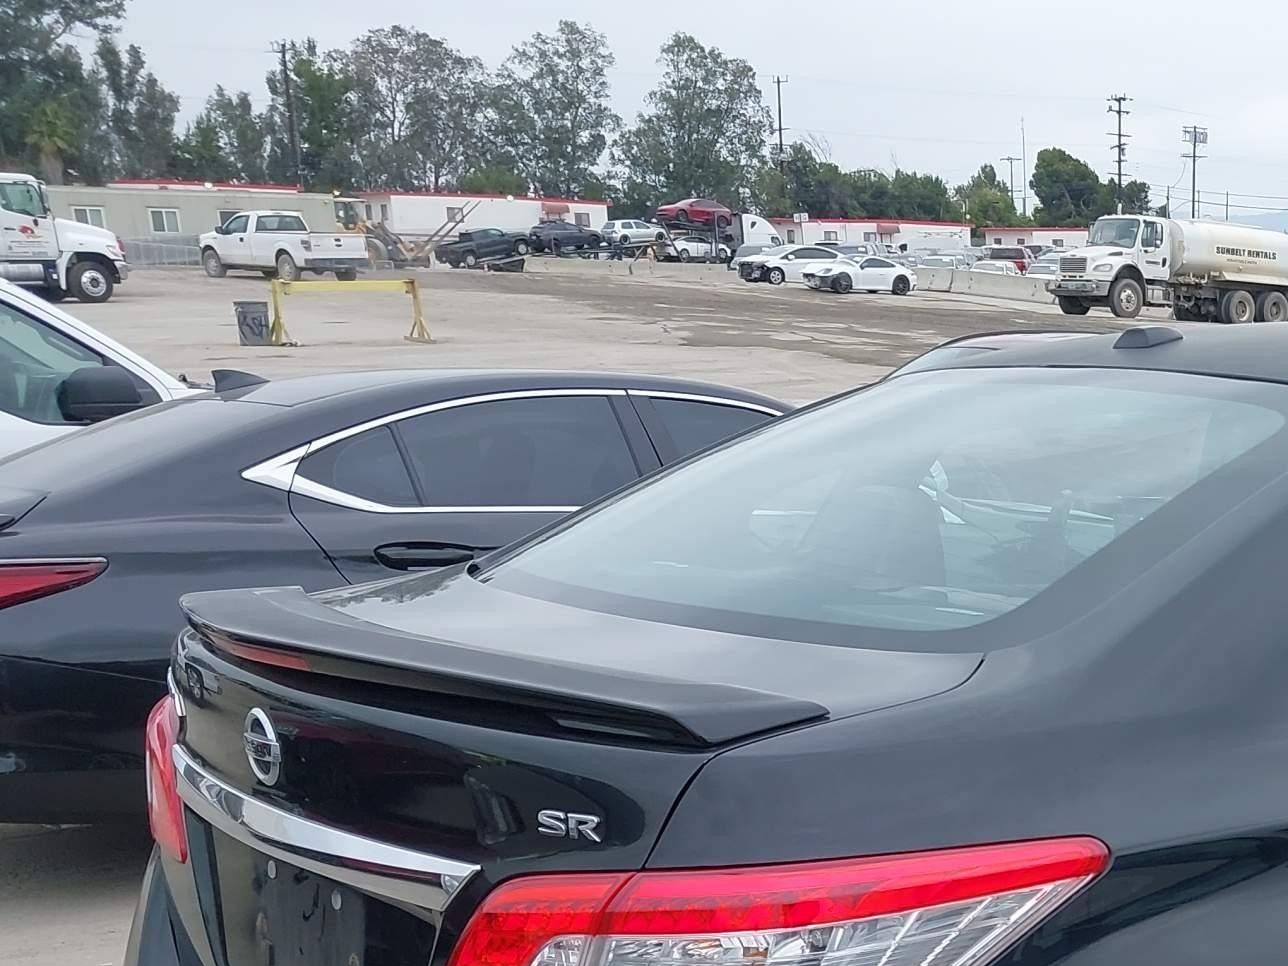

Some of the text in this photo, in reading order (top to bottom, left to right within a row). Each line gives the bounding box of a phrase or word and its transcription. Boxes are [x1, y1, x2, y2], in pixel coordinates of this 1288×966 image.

[1216, 246, 1277, 260] SUNBELT RENTALS
[538, 809, 601, 842] SR
